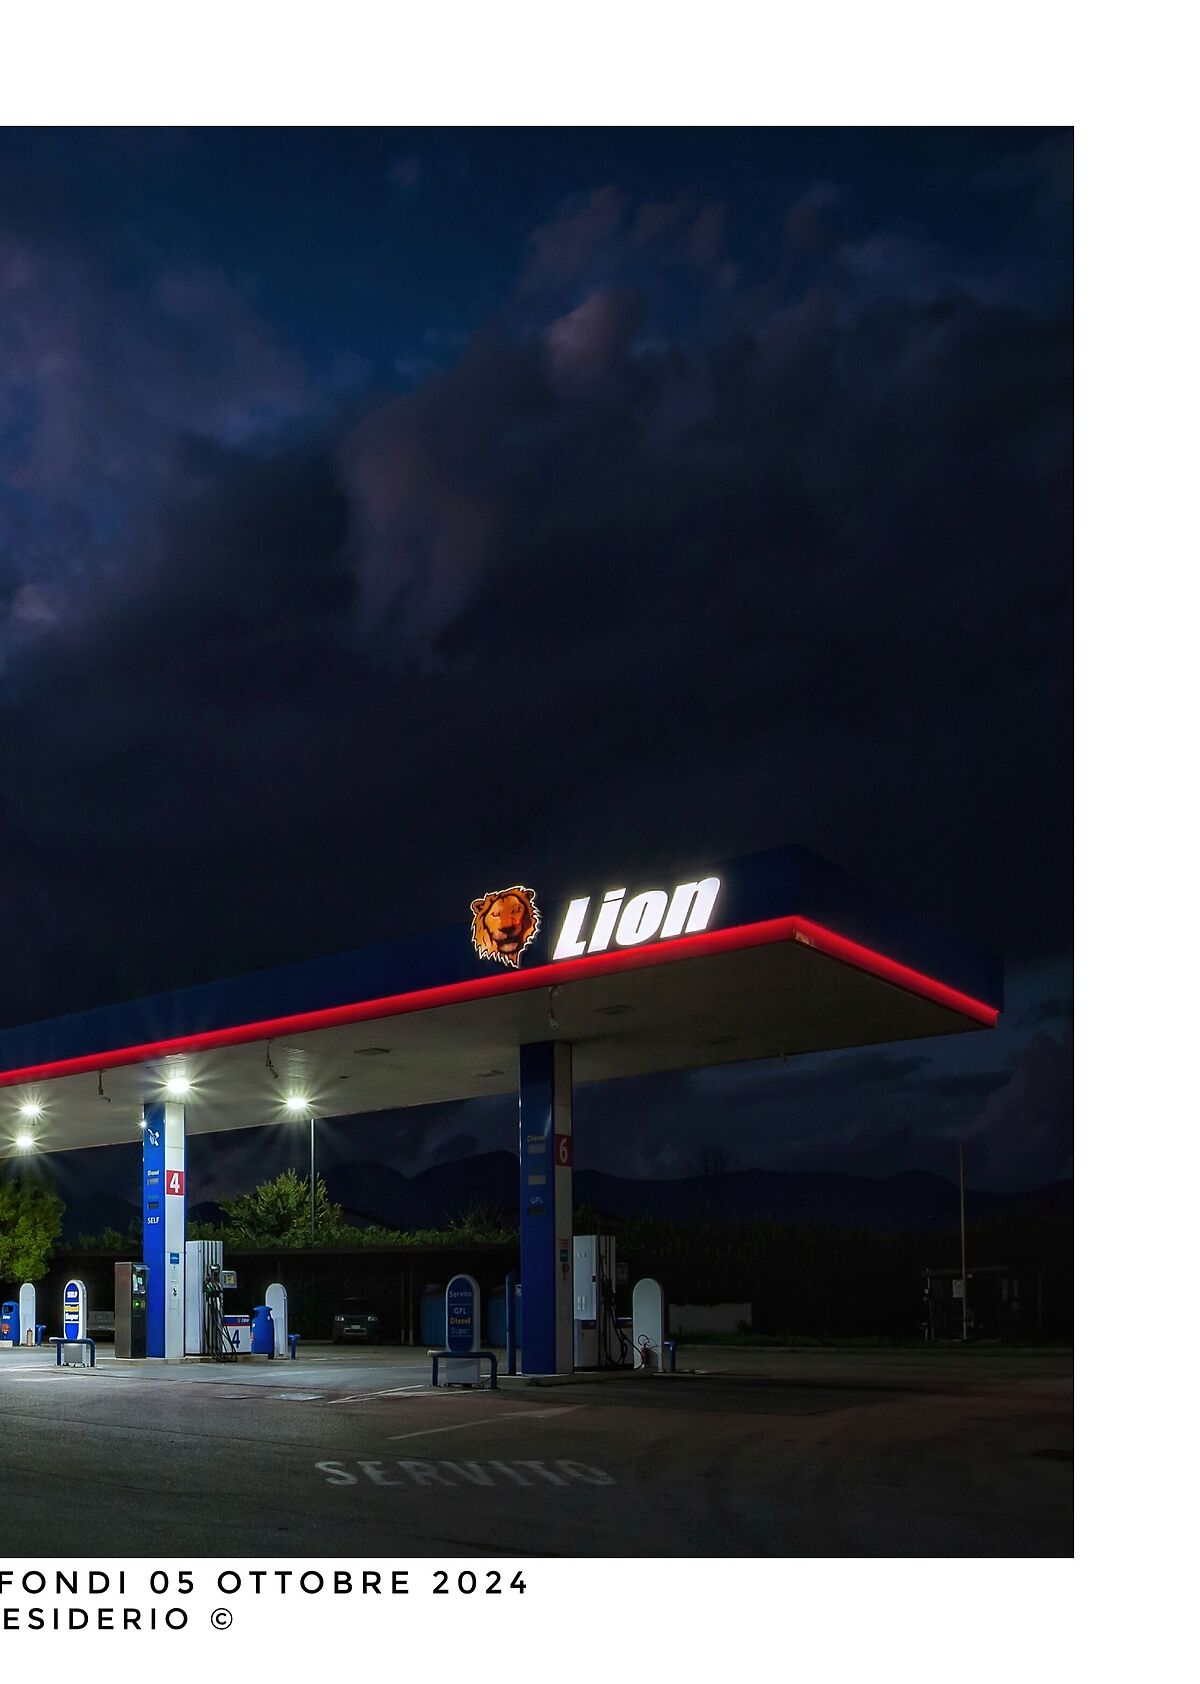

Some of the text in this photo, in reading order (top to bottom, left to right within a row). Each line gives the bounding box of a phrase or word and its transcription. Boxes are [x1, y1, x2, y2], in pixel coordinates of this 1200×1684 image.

[553, 877, 721, 960] Lion
[559, 1138, 568, 1164] 6
[169, 1173, 180, 1193] 4
[147, 1216, 160, 1225] SELF
[449, 1317, 471, 1325] Diesel
[232, 1330, 241, 1348] 4
[314, 1459, 616, 1486] SERVITO
